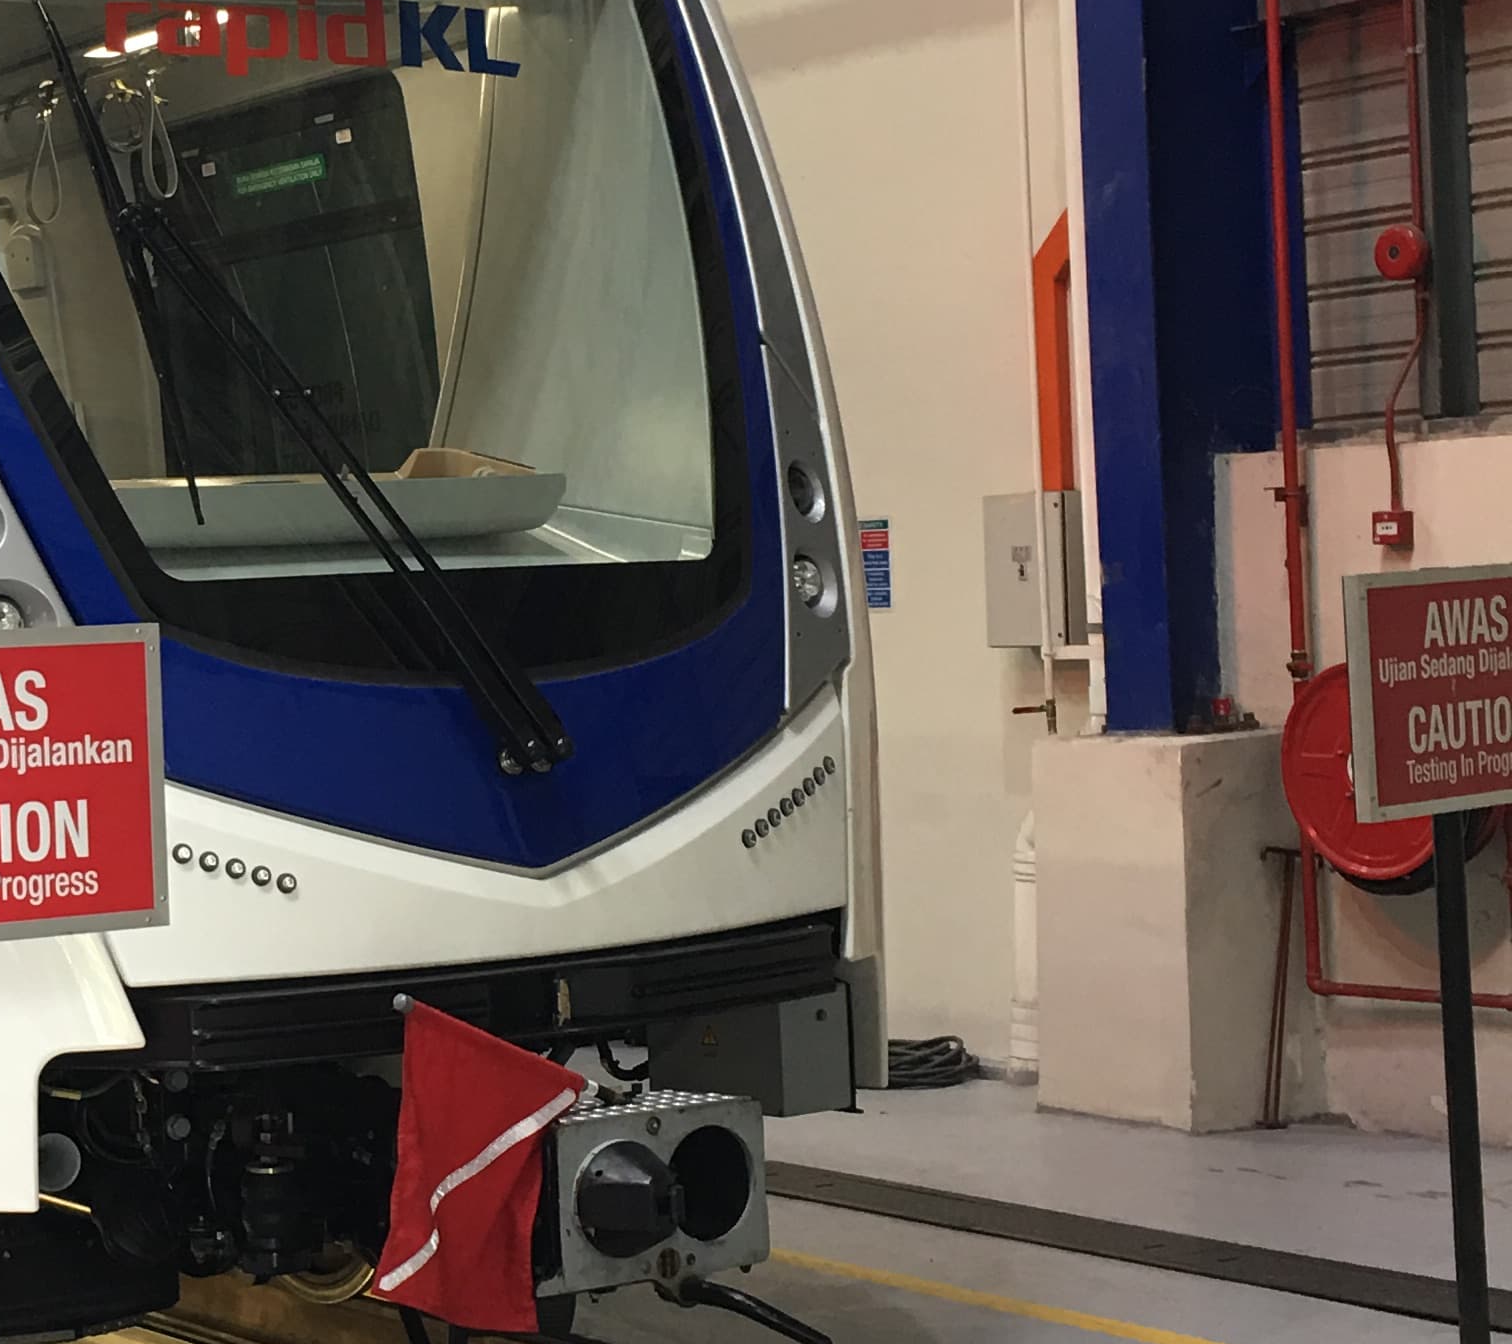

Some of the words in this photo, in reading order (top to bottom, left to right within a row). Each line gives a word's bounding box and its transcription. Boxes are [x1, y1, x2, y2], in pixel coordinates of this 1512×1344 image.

[1424, 594, 1509, 649] AWAS
[1378, 659, 1417, 688] Ujian
[1420, 652, 1475, 680] Sedang
[1479, 645, 1512, 676] Dijal
[1407, 696, 1512, 755] CAUTIO
[1405, 759, 1458, 785] Testing
[1460, 754, 1474, 777] In
[1478, 751, 1512, 777] Prog
